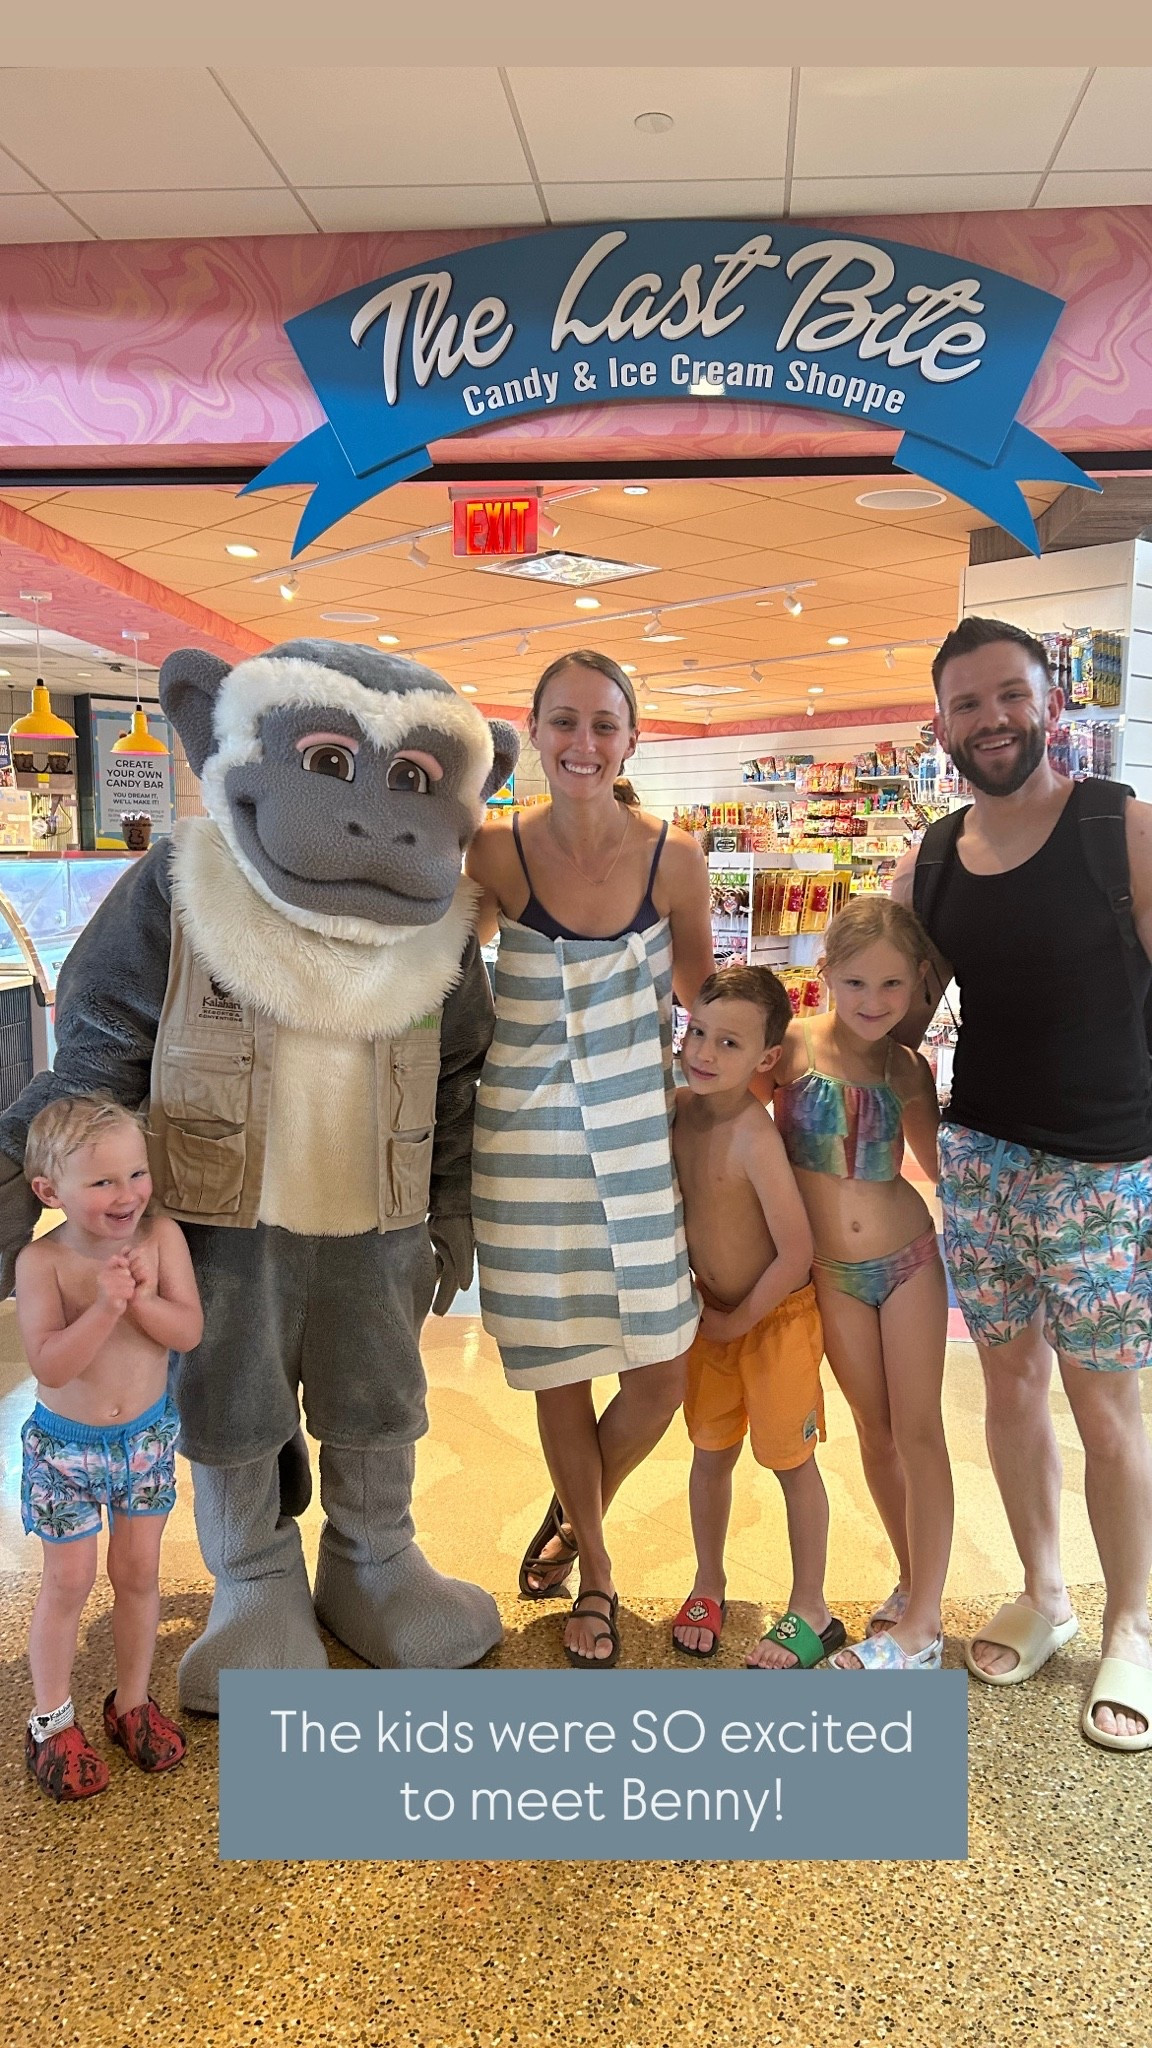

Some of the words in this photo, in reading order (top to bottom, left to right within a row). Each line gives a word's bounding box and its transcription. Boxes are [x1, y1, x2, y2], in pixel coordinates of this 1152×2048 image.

[350, 271, 514, 406] The
[550, 230, 781, 352] Last
[775, 238, 986, 383] Bite
[462, 367, 560, 417] Candy
[572, 361, 598, 392] &
[608, 357, 658, 388] Ice
[670, 353, 774, 388] Cream
[785, 360, 906, 414] Shoppe
[466, 501, 530, 555] EXIT
[106, 769, 135, 778] YOUR
[137, 770, 163, 779] OWN
[115, 759, 154, 769] CREATE
[106, 779, 141, 788] CANDY
[143, 780, 164, 789] BAR
